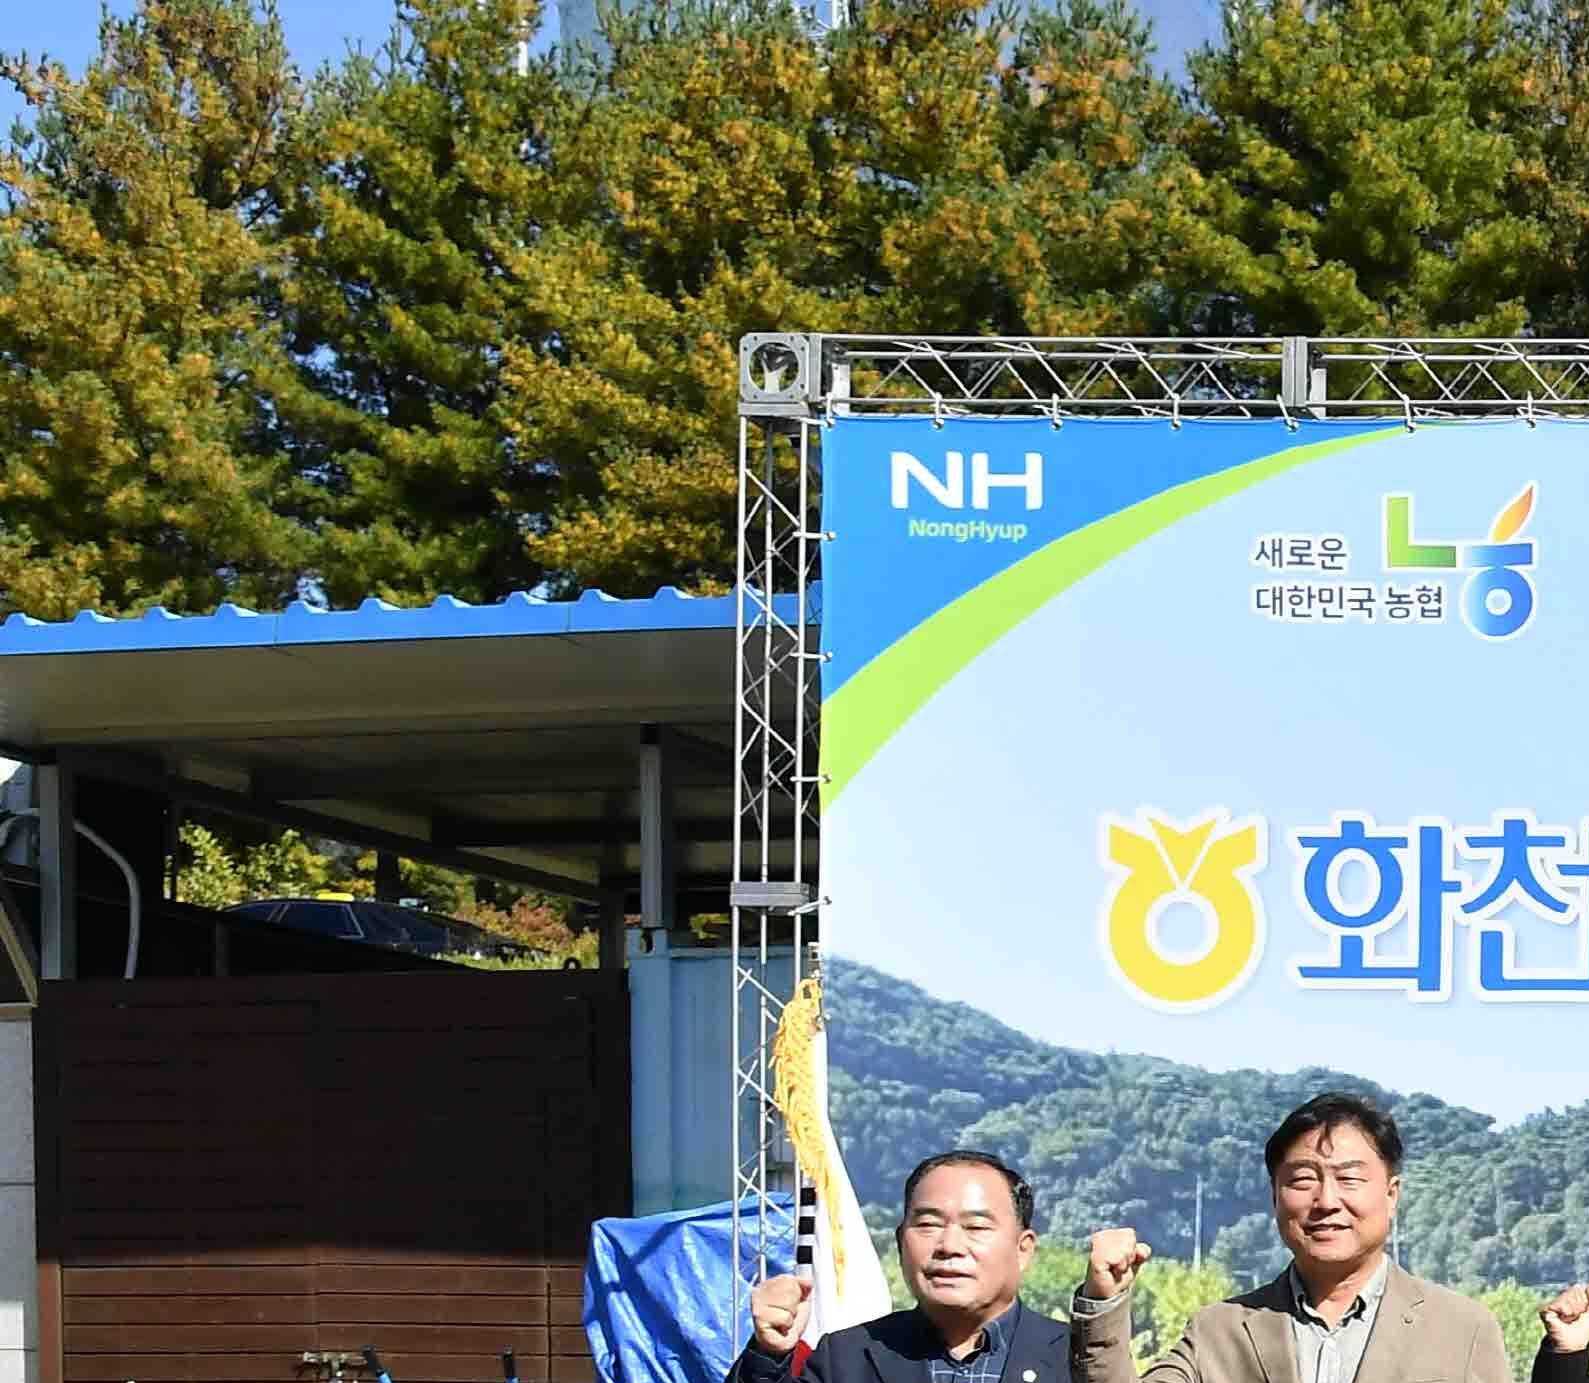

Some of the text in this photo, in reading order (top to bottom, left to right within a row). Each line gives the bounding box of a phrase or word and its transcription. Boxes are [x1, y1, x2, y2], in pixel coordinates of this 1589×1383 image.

[890, 451, 1044, 510] NH
[908, 519, 1028, 543] NongHyup
[1255, 537, 1347, 571] 새로운
[1256, 585, 1443, 619] 대한민국 농협
